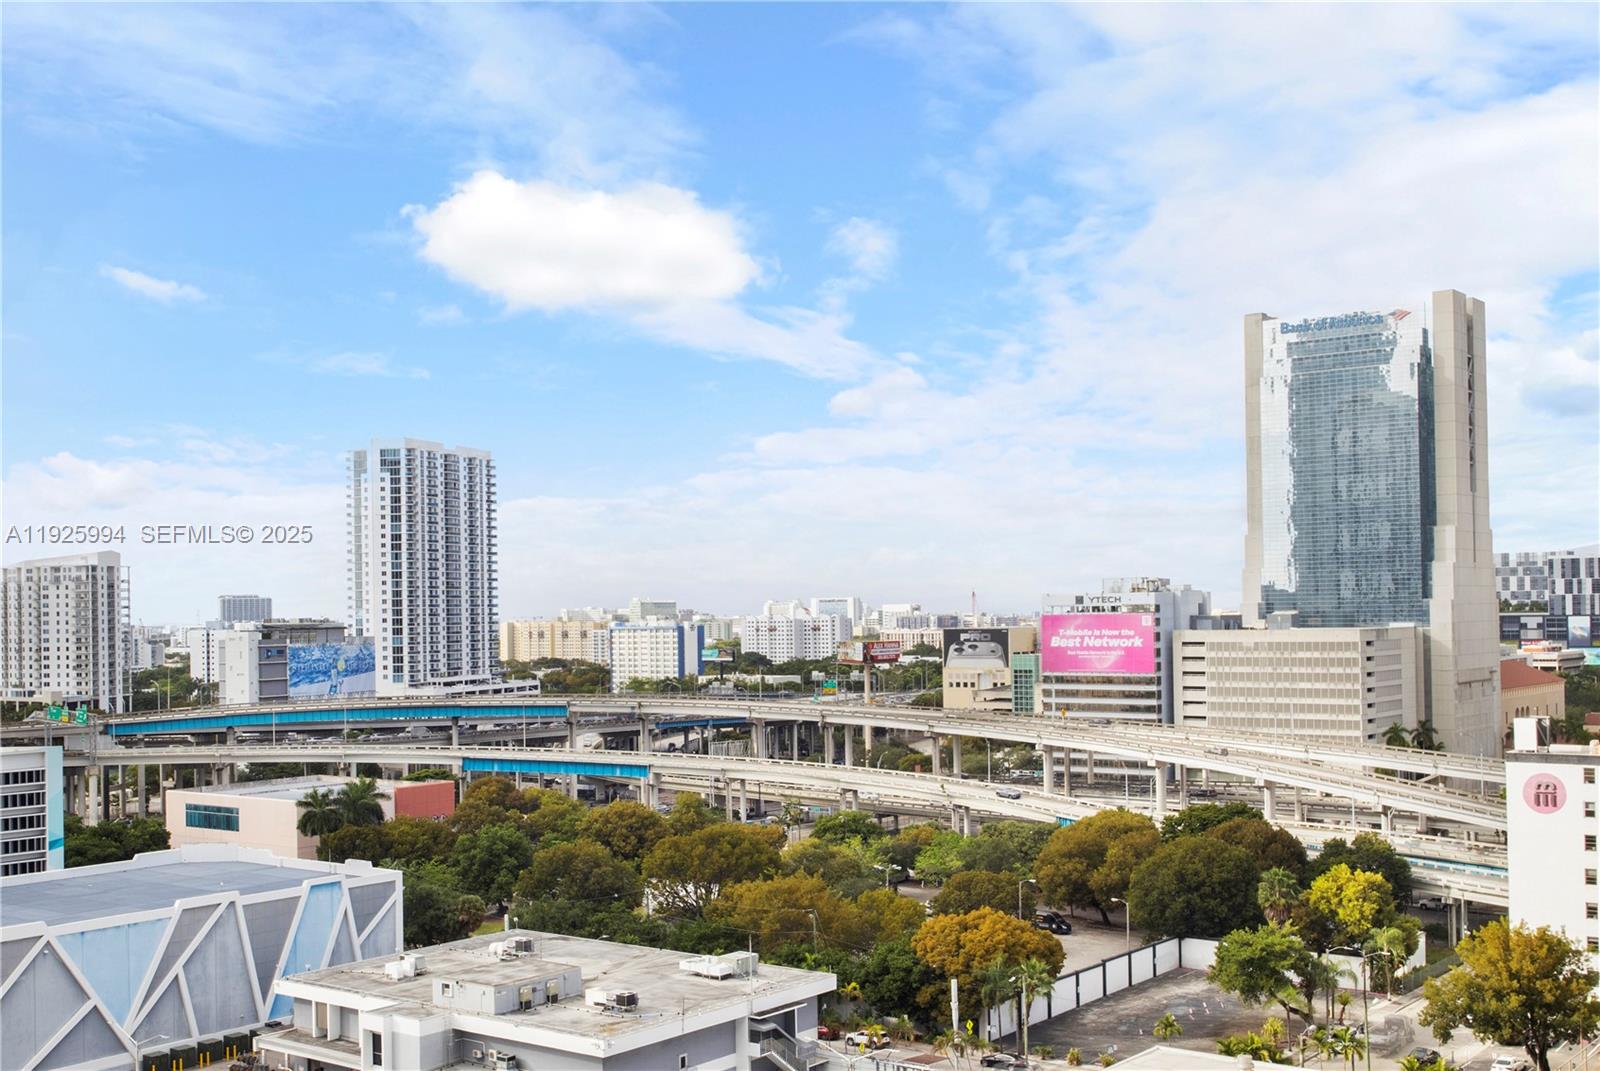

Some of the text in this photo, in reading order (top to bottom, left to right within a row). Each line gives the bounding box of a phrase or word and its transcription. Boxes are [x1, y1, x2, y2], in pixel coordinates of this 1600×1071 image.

[1280, 313, 1384, 334] Bank of America
[1088, 595, 1122, 604] YTECH
[960, 632, 991, 641] PRO
[1058, 628, 1093, 636] T-Mobile
[1101, 628, 1121, 636] Now
[1121, 628, 1136, 636] the
[1050, 636, 1144, 647] Best Network
